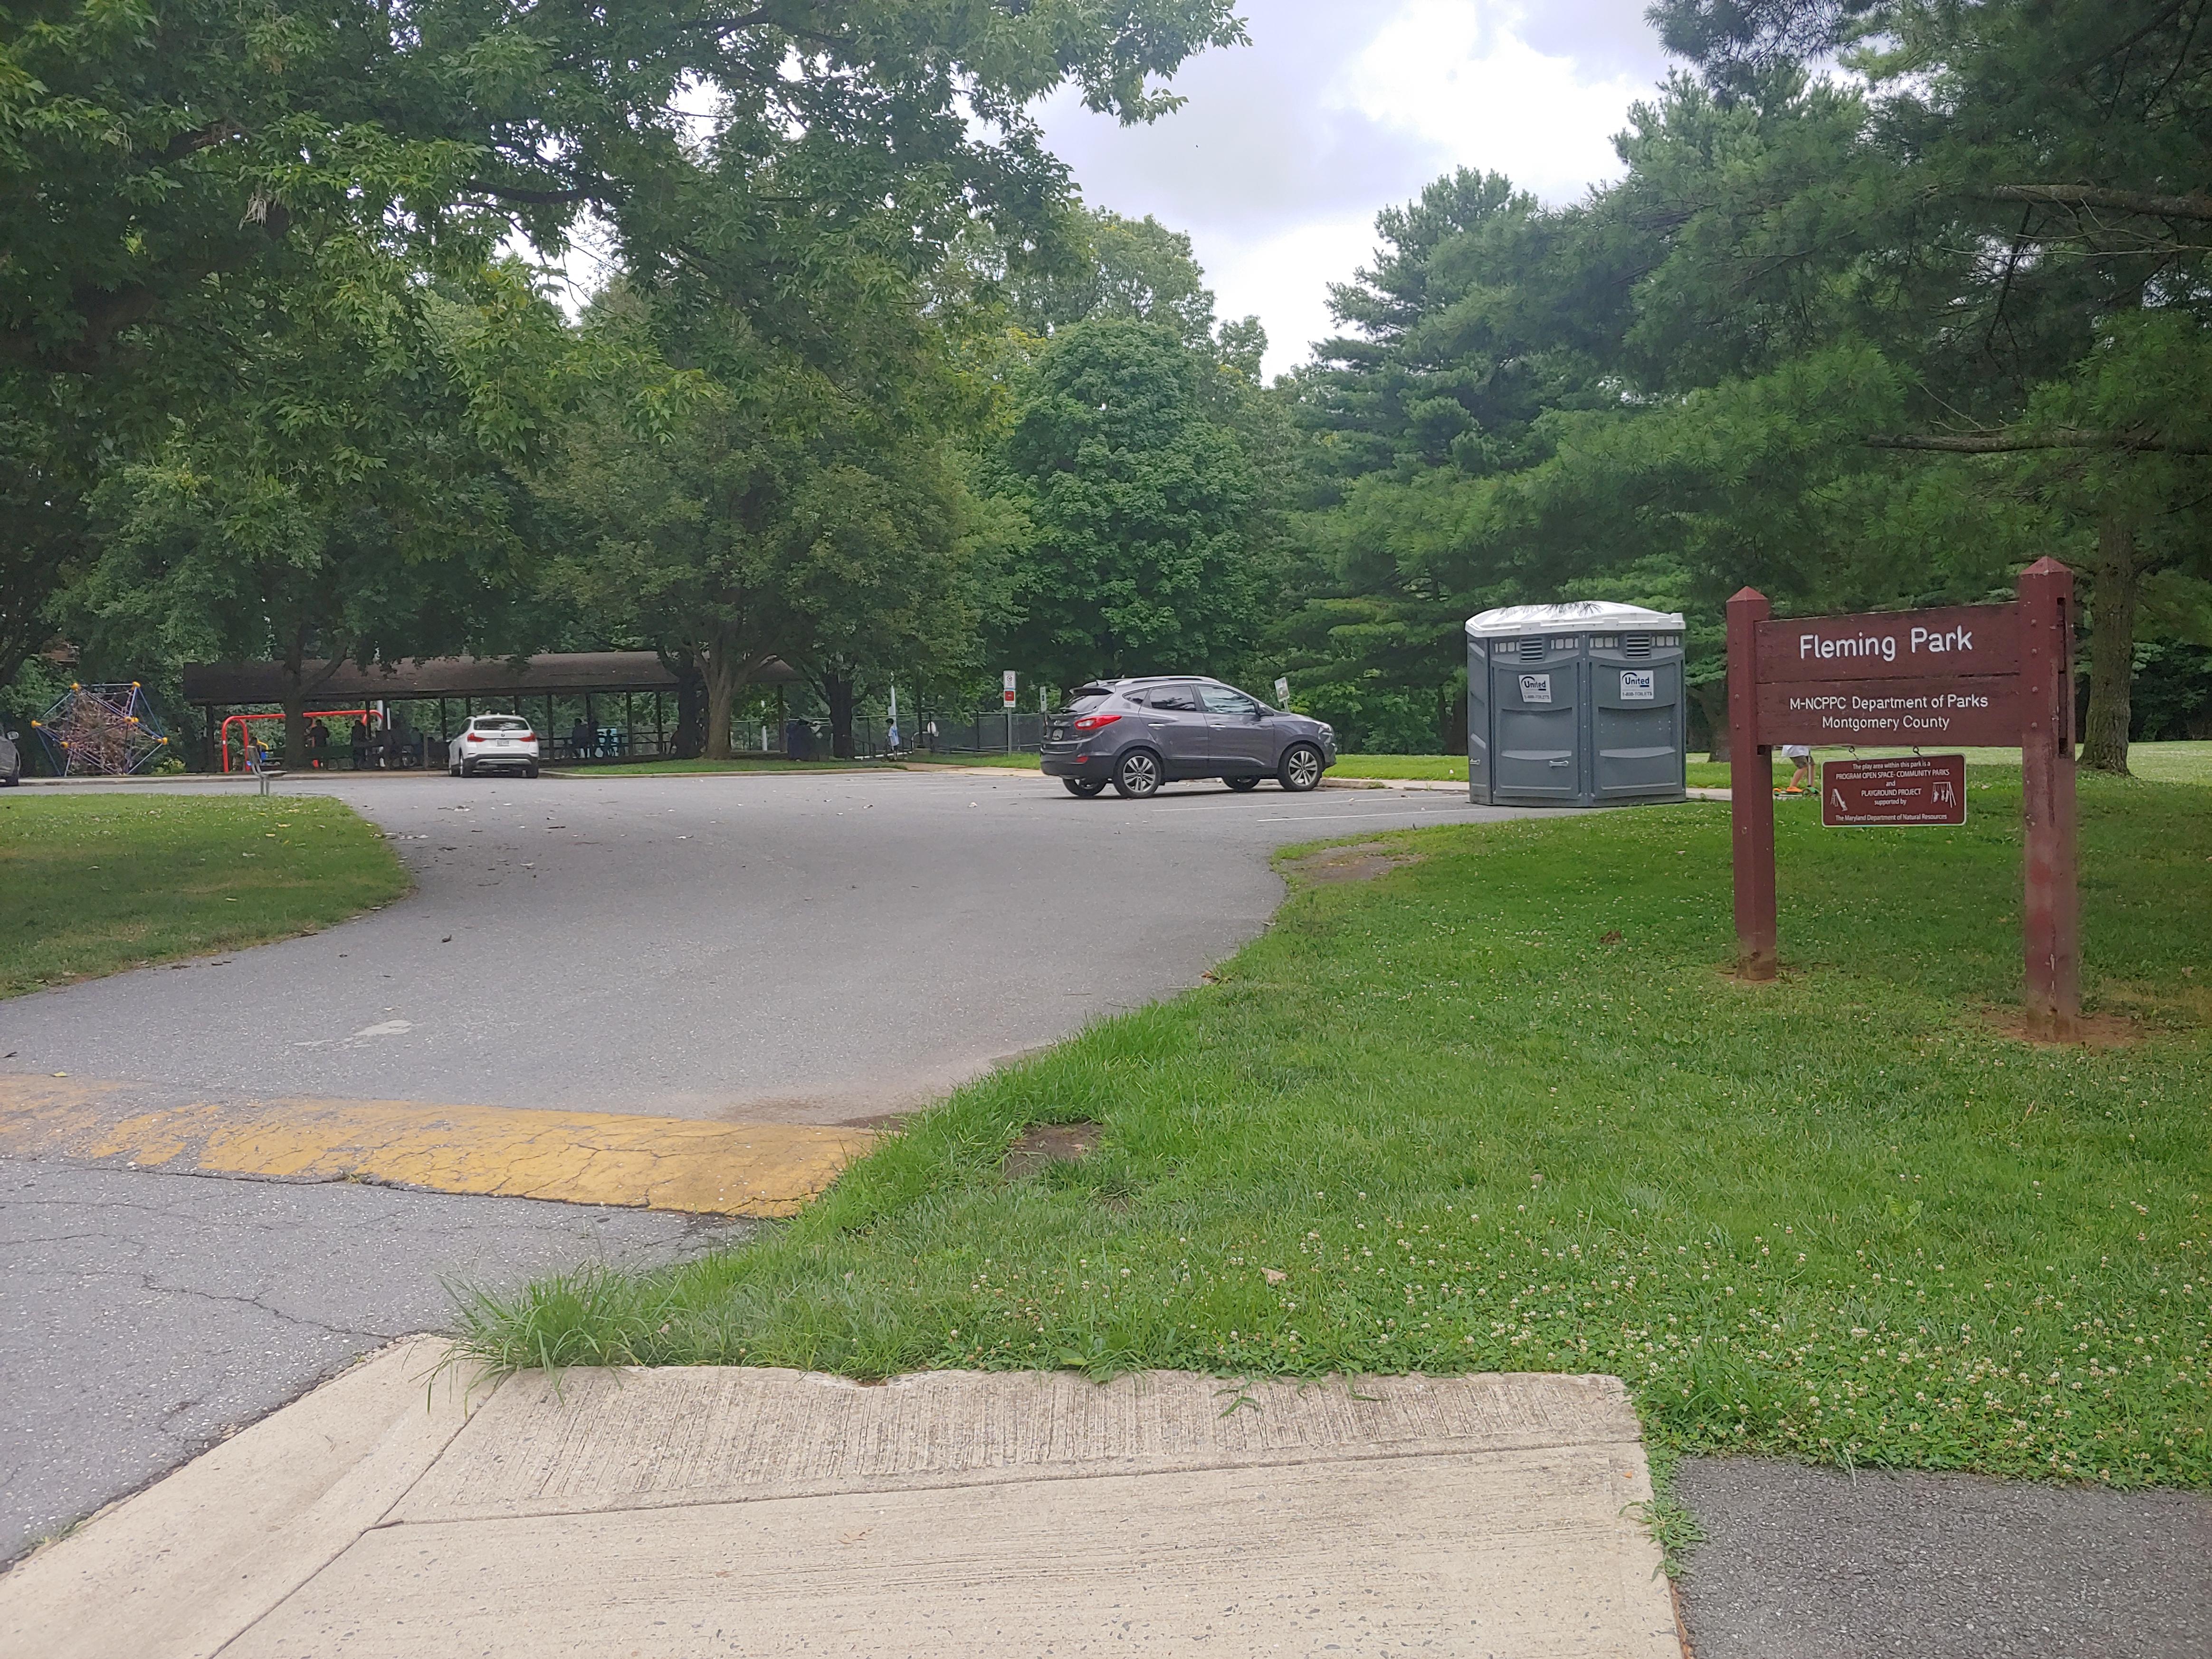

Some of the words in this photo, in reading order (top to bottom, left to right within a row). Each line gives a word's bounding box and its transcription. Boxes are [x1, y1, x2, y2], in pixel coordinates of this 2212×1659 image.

[1800, 631, 1896, 662] Fleming
[1910, 625, 1974, 653] Park
[1790, 696, 1847, 710] M-NCPPC
[1852, 696, 1927, 712] Department
[1931, 695, 1945, 708] of
[1947, 694, 1989, 708] Parks
[1822, 715, 1899, 731] Montgomery
[1903, 715, 1950, 731] County
[1862, 763, 1872, 771] play
